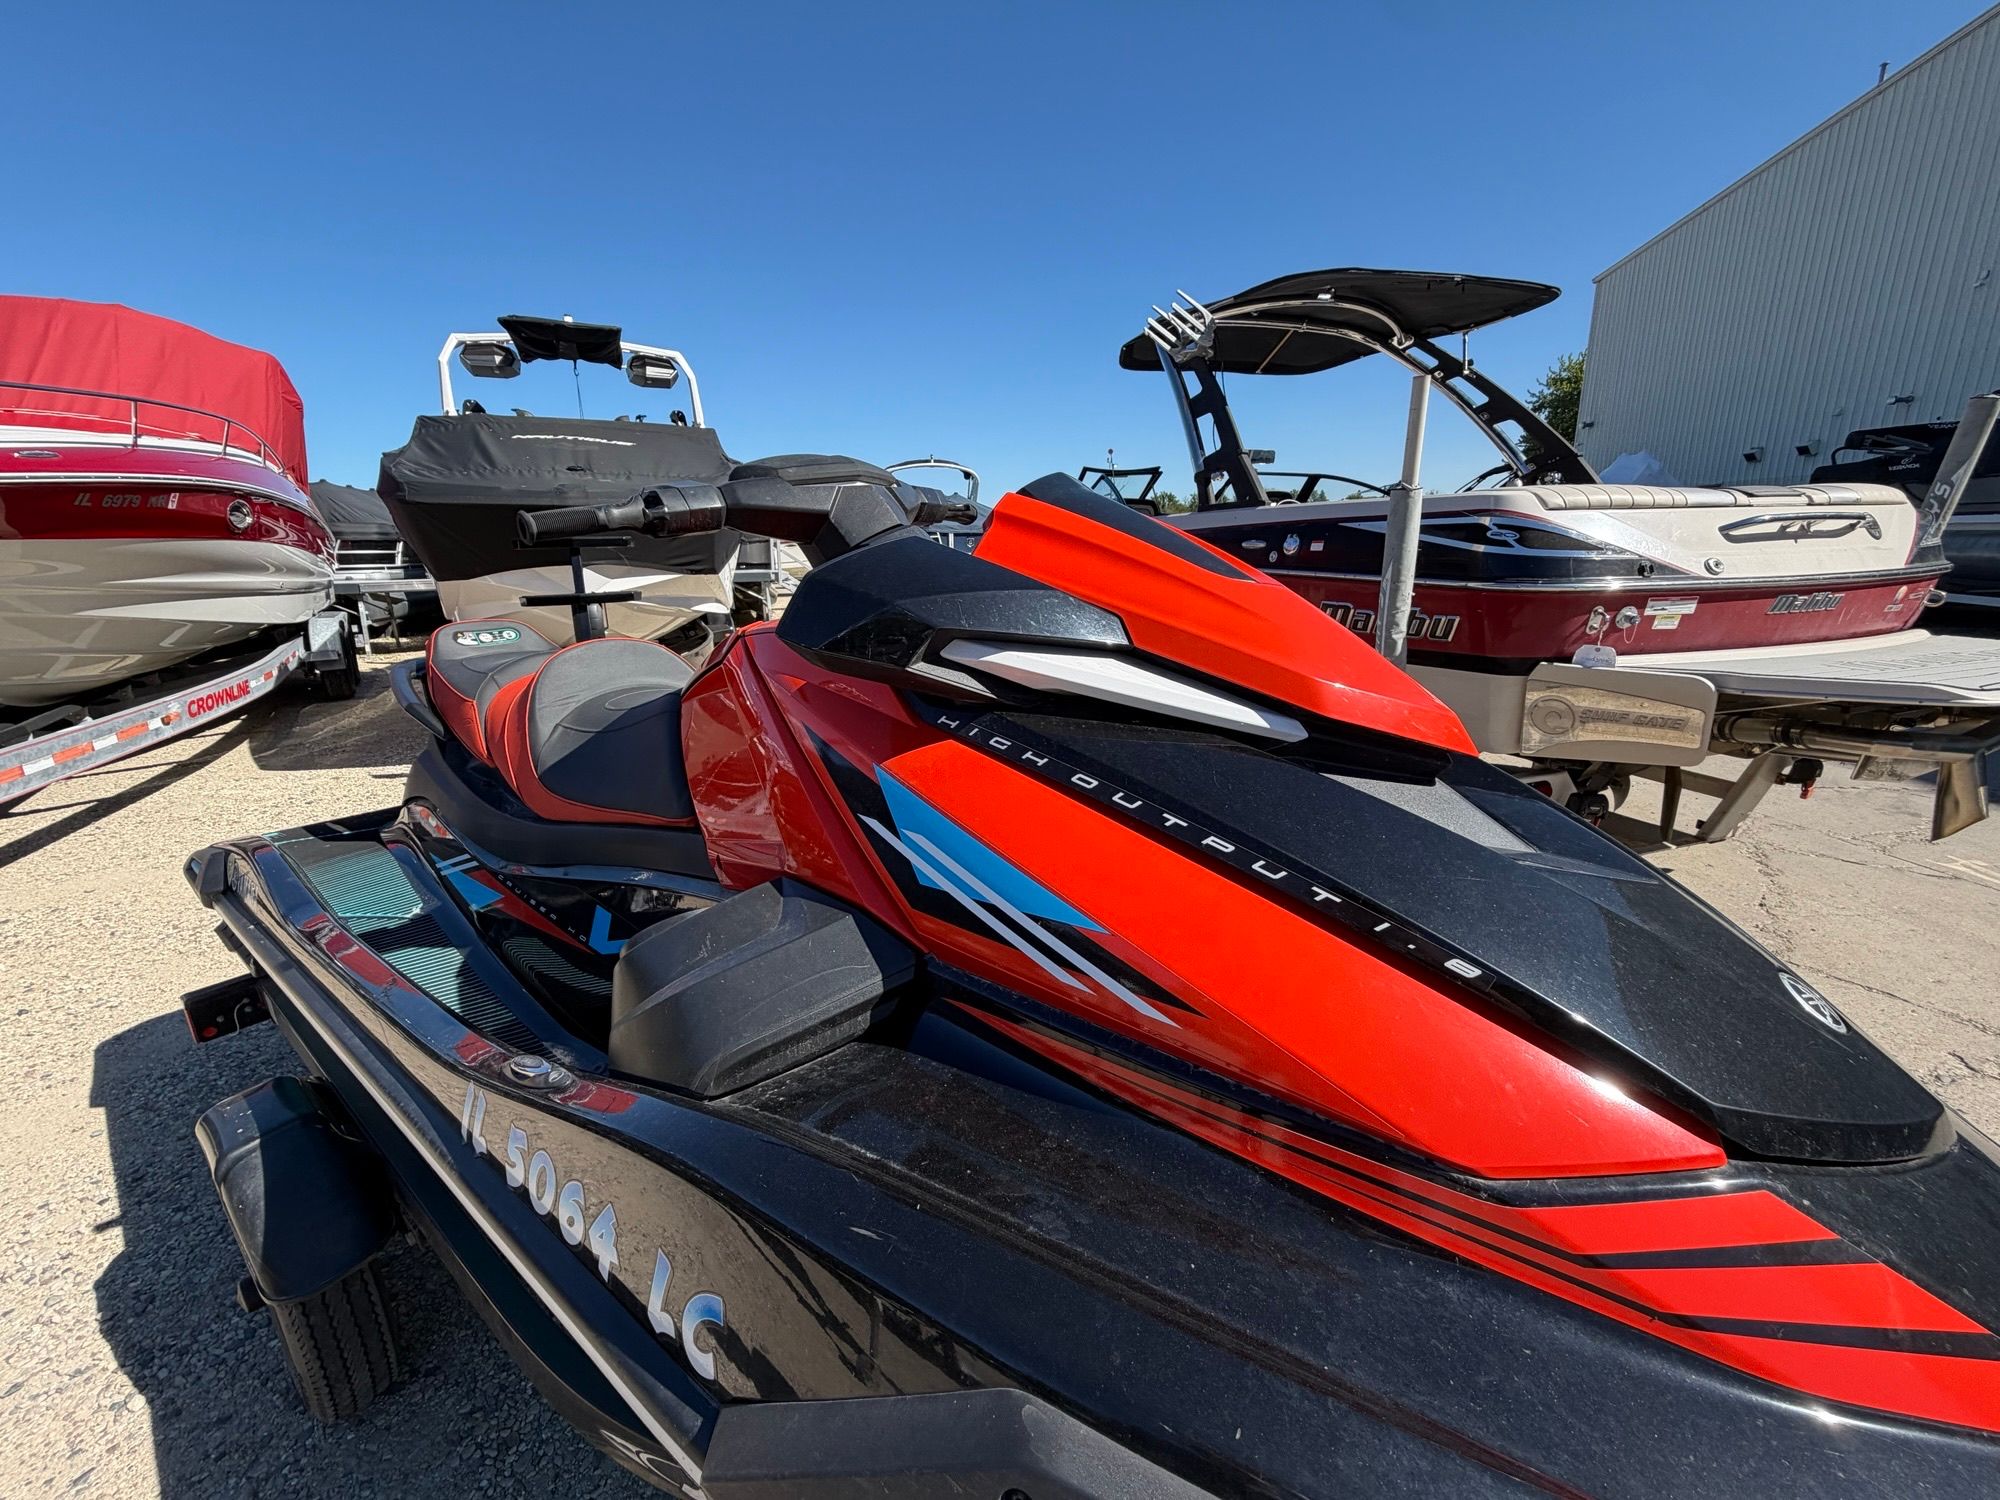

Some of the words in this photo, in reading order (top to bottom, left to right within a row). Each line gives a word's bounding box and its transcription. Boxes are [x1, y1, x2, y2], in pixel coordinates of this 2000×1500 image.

[73, 492, 92, 506] IL
[102, 494, 142, 508] 6979
[1320, 600, 1460, 642] Mabu
[1766, 592, 1846, 615] Malibu
[187, 679, 251, 718] CROWNLINE
[1632, 715, 1691, 732] GATE
[937, 715, 1049, 767] HIGH
[1071, 773, 1343, 903] OUTPUT
[498, 874, 557, 921] CRUISER
[461, 1080, 488, 1155] IL
[505, 1123, 619, 1282] 5064
[647, 1248, 724, 1380] LC
